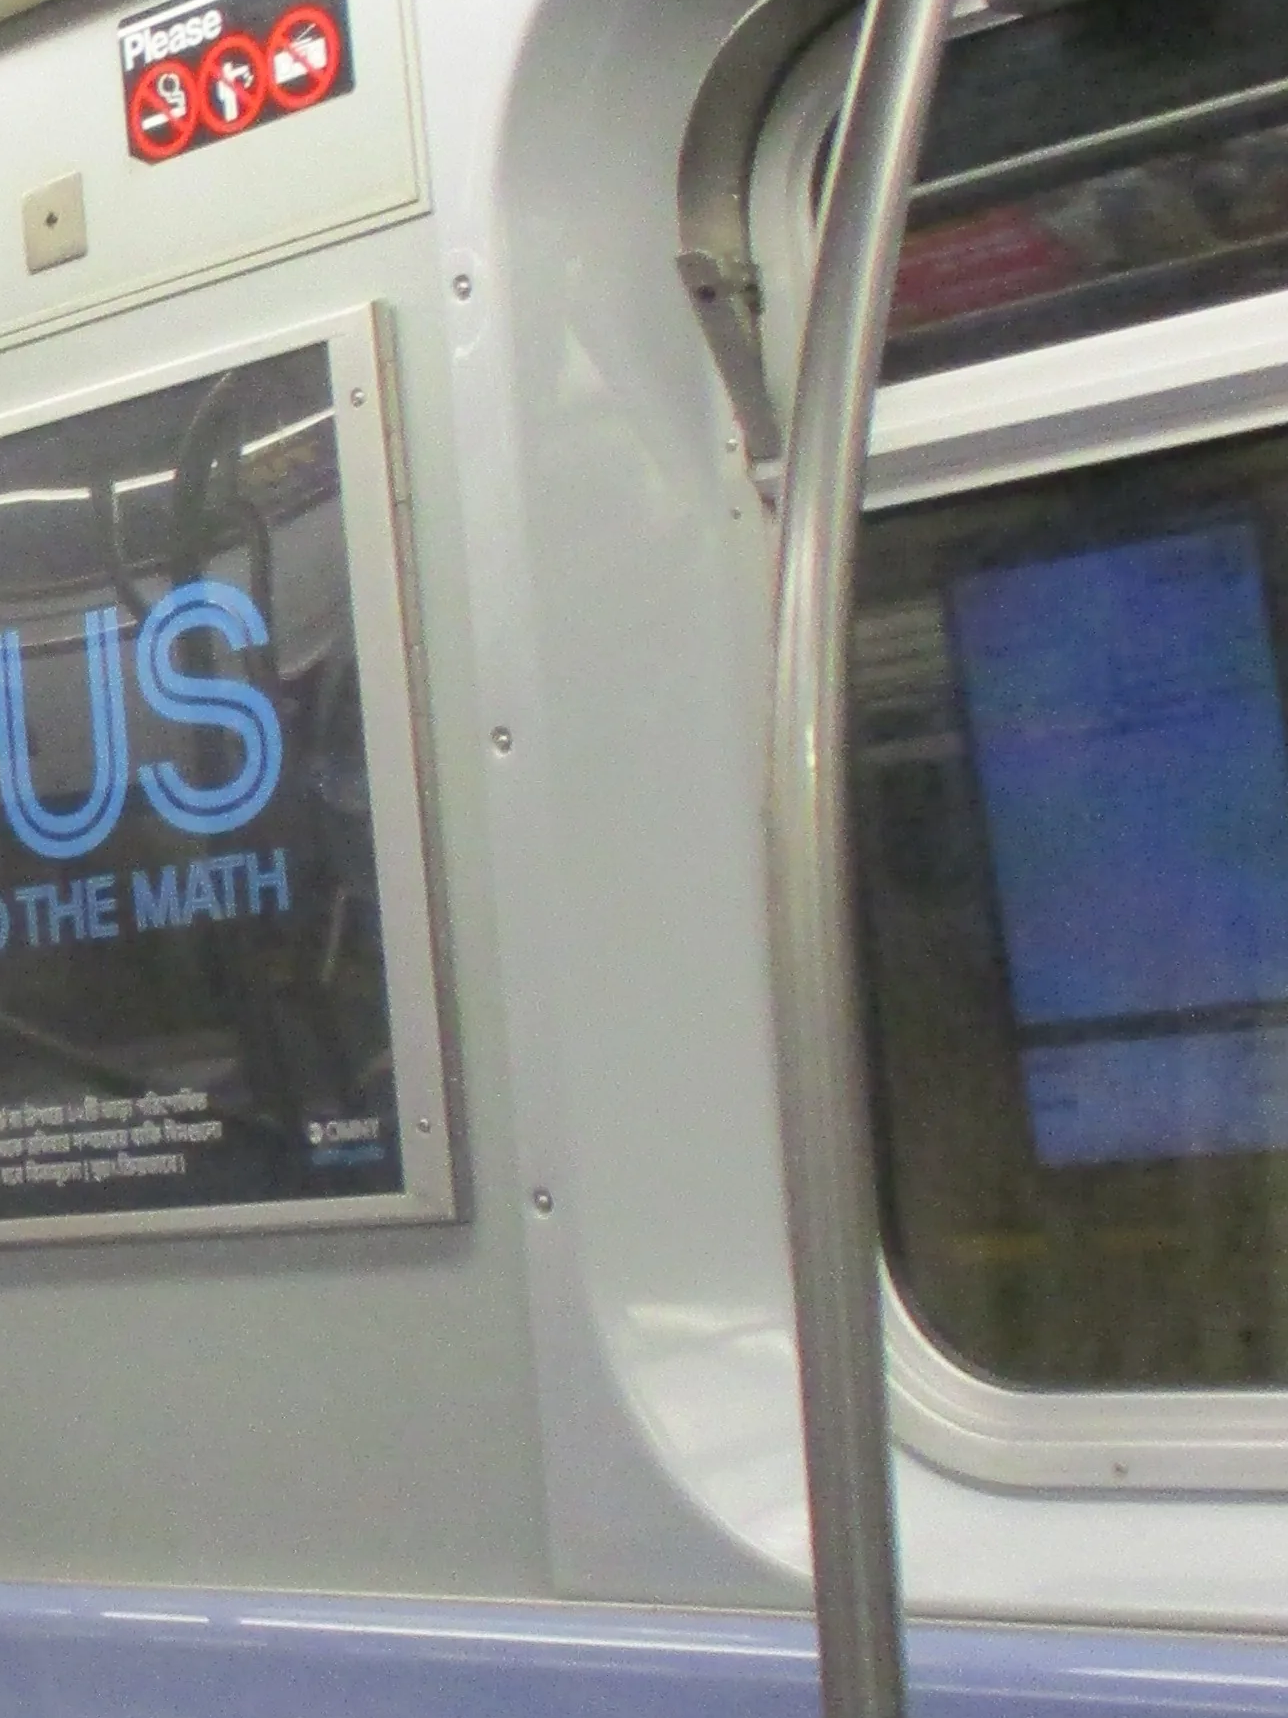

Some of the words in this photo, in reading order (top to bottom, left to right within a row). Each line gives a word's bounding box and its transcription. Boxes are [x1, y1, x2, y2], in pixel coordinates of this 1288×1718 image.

[123, 8, 224, 72] Please
[15, 874, 120, 947] THE
[132, 847, 292, 935] MATH
